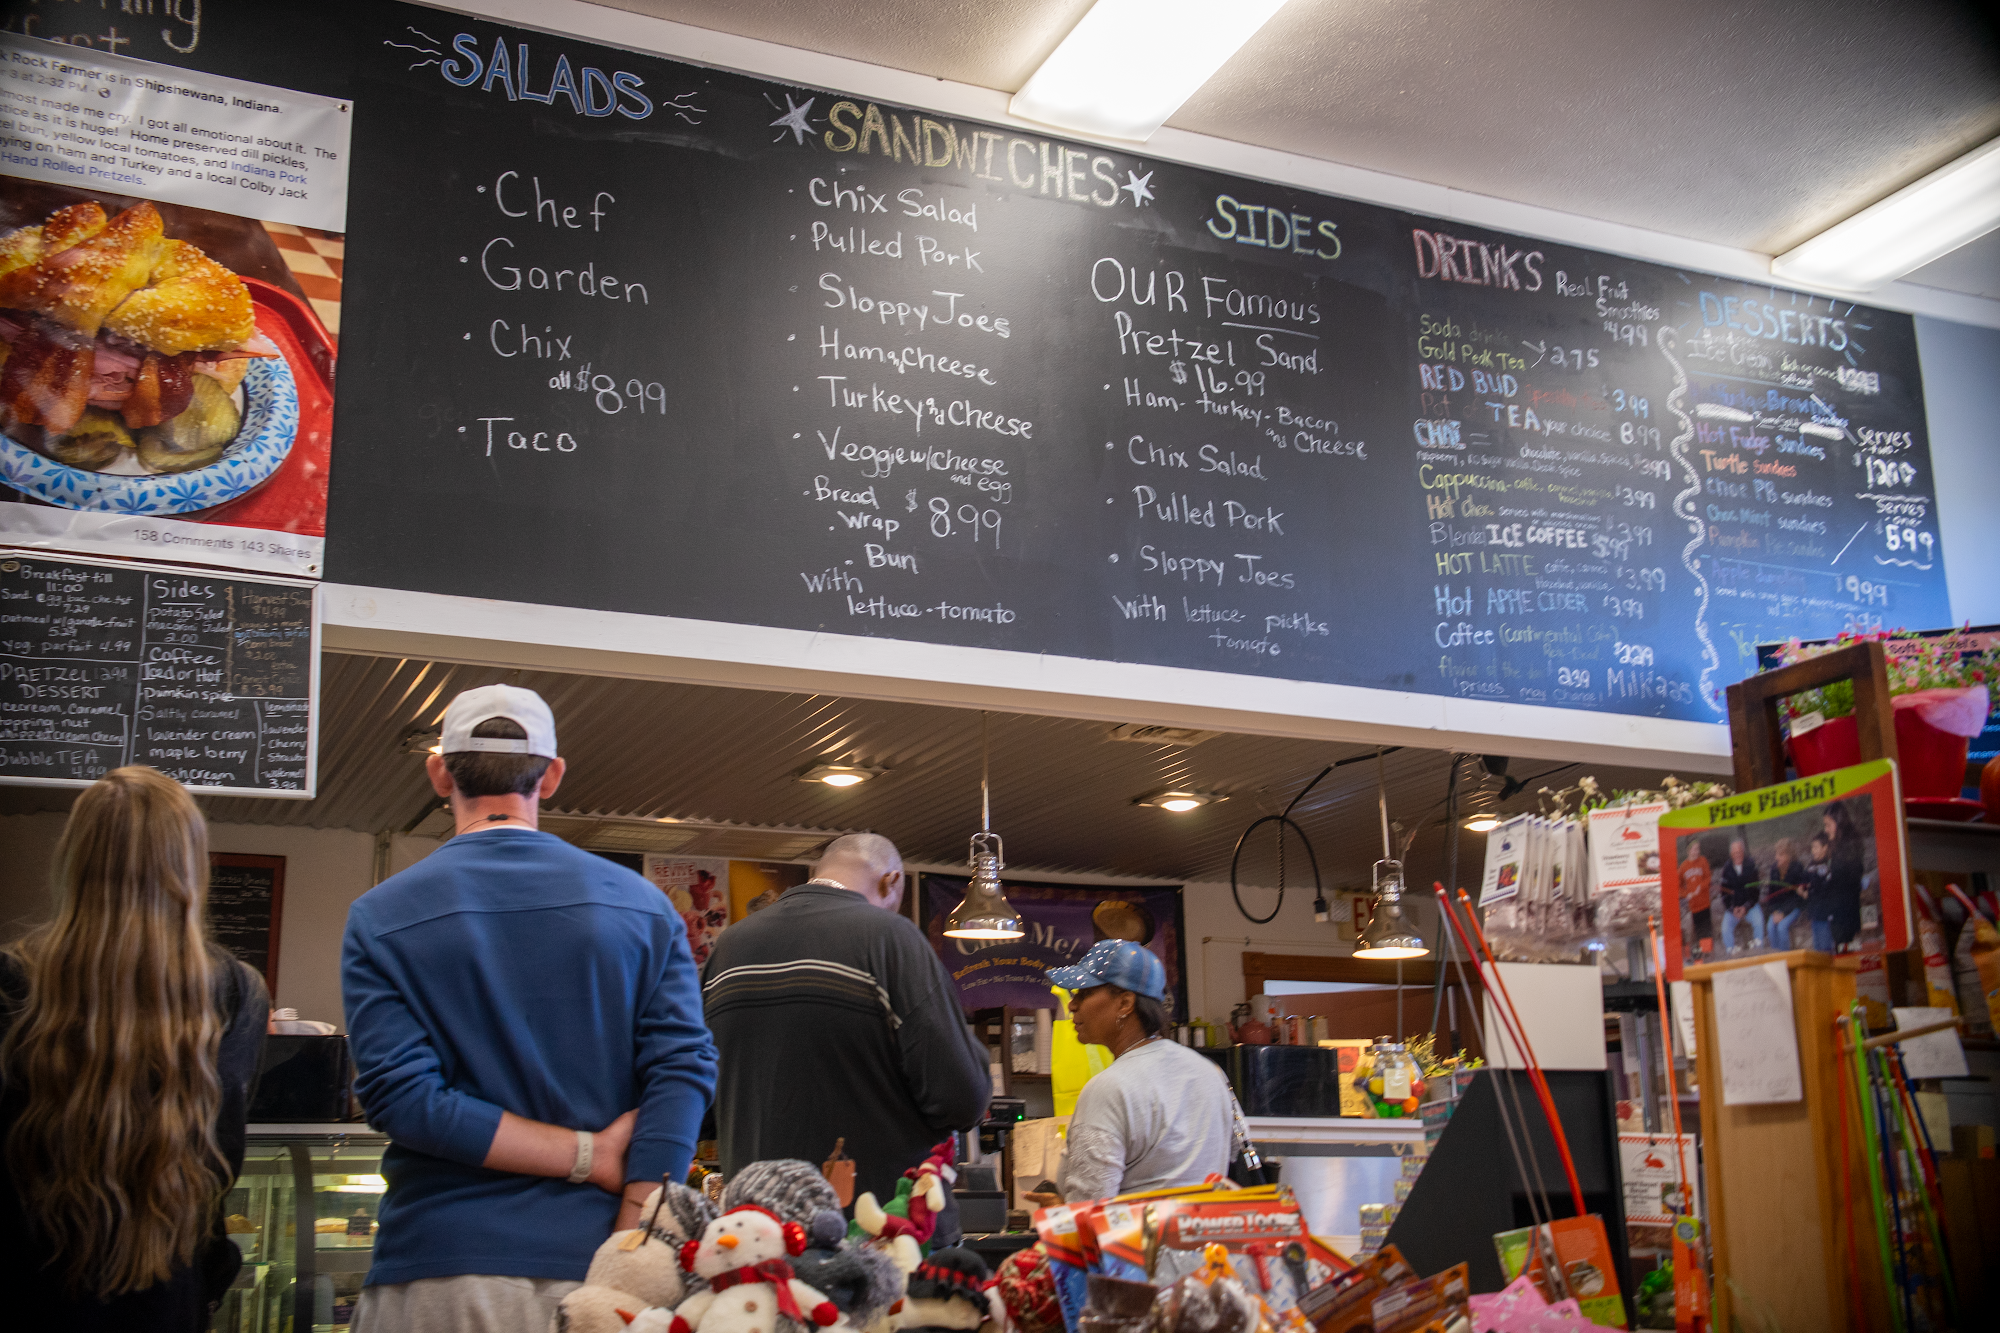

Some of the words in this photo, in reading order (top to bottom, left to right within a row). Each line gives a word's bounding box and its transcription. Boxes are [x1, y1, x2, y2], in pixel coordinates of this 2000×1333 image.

[10, 69, 18, 79] 3
[22, 73, 34, 83] at
[38, 75, 65, 88] 2:32
[68, 81, 88, 93] PM
[12, 52, 48, 69] Rock
[51, 60, 102, 80] Farmer
[105, 72, 116, 83] is
[120, 74, 132, 87] in
[135, 77, 228, 106] Shipshewana,
[232, 96, 284, 114] Indiana.
[440, 33, 654, 120] SALADS
[33, 111, 49, 122] as
[53, 114, 62, 125] it
[66, 116, 77, 128] is
[80, 118, 119, 137] huge!
[130, 129, 169, 146] Home
[172, 138, 237, 156] preserved
[241, 148, 259, 160] dill
[262, 152, 309, 172] pickles,
[41, 99, 80, 114] made
[83, 106, 105, 119] me
[108, 111, 132, 125] cry.
[139, 115, 144, 125] I
[147, 118, 170, 130] got
[172, 123, 187, 133] all
[190, 126, 253, 144] emotional
[256, 137, 293, 151] about
[295, 143, 307, 155] it.
[314, 147, 337, 160] The
[1, 151, 38, 167] Hand
[42, 158, 85, 175] Rolled
[89, 166, 147, 186] Pretzels.
[19, 121, 49, 138] bun,
[53, 130, 97, 147] yellow
[100, 138, 131, 154] local
[135, 145, 199, 166] tomatoes,
[203, 158, 227, 170] and
[231, 160, 276, 179] Indiana
[279, 170, 308, 185] Pork
[824, 100, 1120, 208] SANDWICHES
[35, 143, 54, 153] on
[57, 145, 87, 159] ham
[90, 153, 116, 165] and
[120, 156, 164, 175] Turkey
[167, 166, 191, 178] and
[195, 171, 203, 180] a
[207, 171, 236, 186] local
[240, 178, 276, 196] Colby
[278, 186, 308, 200] Jack
[494, 170, 616, 233] Chef
[808, 176, 889, 214] Chix
[896, 188, 979, 232] Salad
[1206, 193, 1342, 260] SIDES
[810, 220, 903, 259] Pulled
[914, 233, 985, 275] Pork
[1412, 228, 1545, 293] DRINKS
[480, 237, 649, 306] Garden
[817, 271, 929, 331] Sloppy
[931, 289, 1011, 339] Joes
[1090, 257, 1188, 314] OUR
[1200, 275, 1322, 325] Famous
[1419, 313, 1462, 339] Soda
[1699, 289, 1849, 352] DESSERTS
[490, 318, 573, 361] Chix
[1113, 310, 1237, 368] Pretzel
[1417, 335, 1457, 362] Gold
[1495, 351, 1527, 372] Tea
[548, 369, 572, 391] all
[574, 362, 667, 416] $8.99
[1419, 362, 1465, 393] RED
[1471, 367, 1519, 398] BUD
[816, 375, 923, 436] Turkey
[1274, 405, 1340, 435] Bacon
[1484, 400, 1542, 433] TEA
[476, 416, 578, 458] Taco
[816, 425, 911, 479] Veggie
[1293, 430, 1370, 462] Cheese
[1127, 434, 1190, 469] Chix
[1198, 443, 1269, 482] Salad
[1699, 448, 1750, 476] Turtle
[813, 474, 880, 511] Bread
[950, 473, 972, 487] and
[976, 477, 1013, 505] egg
[1426, 493, 1457, 521] Hot
[1131, 484, 1216, 529] Pulled
[1222, 499, 1286, 537] Pork
[133, 529, 159, 542] 158
[162, 532, 234, 550] Comments
[240, 540, 264, 553] 143
[267, 543, 312, 559] Shares
[1485, 522, 1525, 549] ICE
[1526, 525, 1590, 549] COFFEE
[20, 564, 91, 583] Breakfast
[91, 571, 114, 583] till
[863, 542, 919, 575] Bun
[1139, 544, 1226, 587] Sloppy
[1233, 552, 1296, 590] Joes
[1434, 551, 1474, 577] HOT
[1479, 551, 1539, 577] LATTE
[46, 580, 85, 593] 11:00
[152, 579, 216, 599] Sides
[1433, 583, 1474, 618] Hot
[1486, 586, 1535, 616] APPLE
[1536, 589, 1591, 615] CIDER
[41, 638, 94, 654] parfait
[1207, 627, 1283, 657] tomato
[1434, 621, 1496, 649] Coffee
[141, 662, 175, 681] Iced
[177, 668, 195, 681] or
[195, 667, 225, 683] Hot
[149, 646, 222, 665] Coffee
[18, 683, 106, 699] DESSERT
[61, 717, 92, 728] nut
[191, 708, 240, 720] caramel
[211, 729, 257, 742] cream
[55, 748, 100, 765] TEA
[149, 746, 201, 761] maple
[204, 745, 249, 765] berry
[1708, 802, 1753, 825] Fire
[1757, 776, 1836, 813] Fishin'!
[1027, 921, 1080, 960] Me!
[1020, 956, 1046, 971] Body
